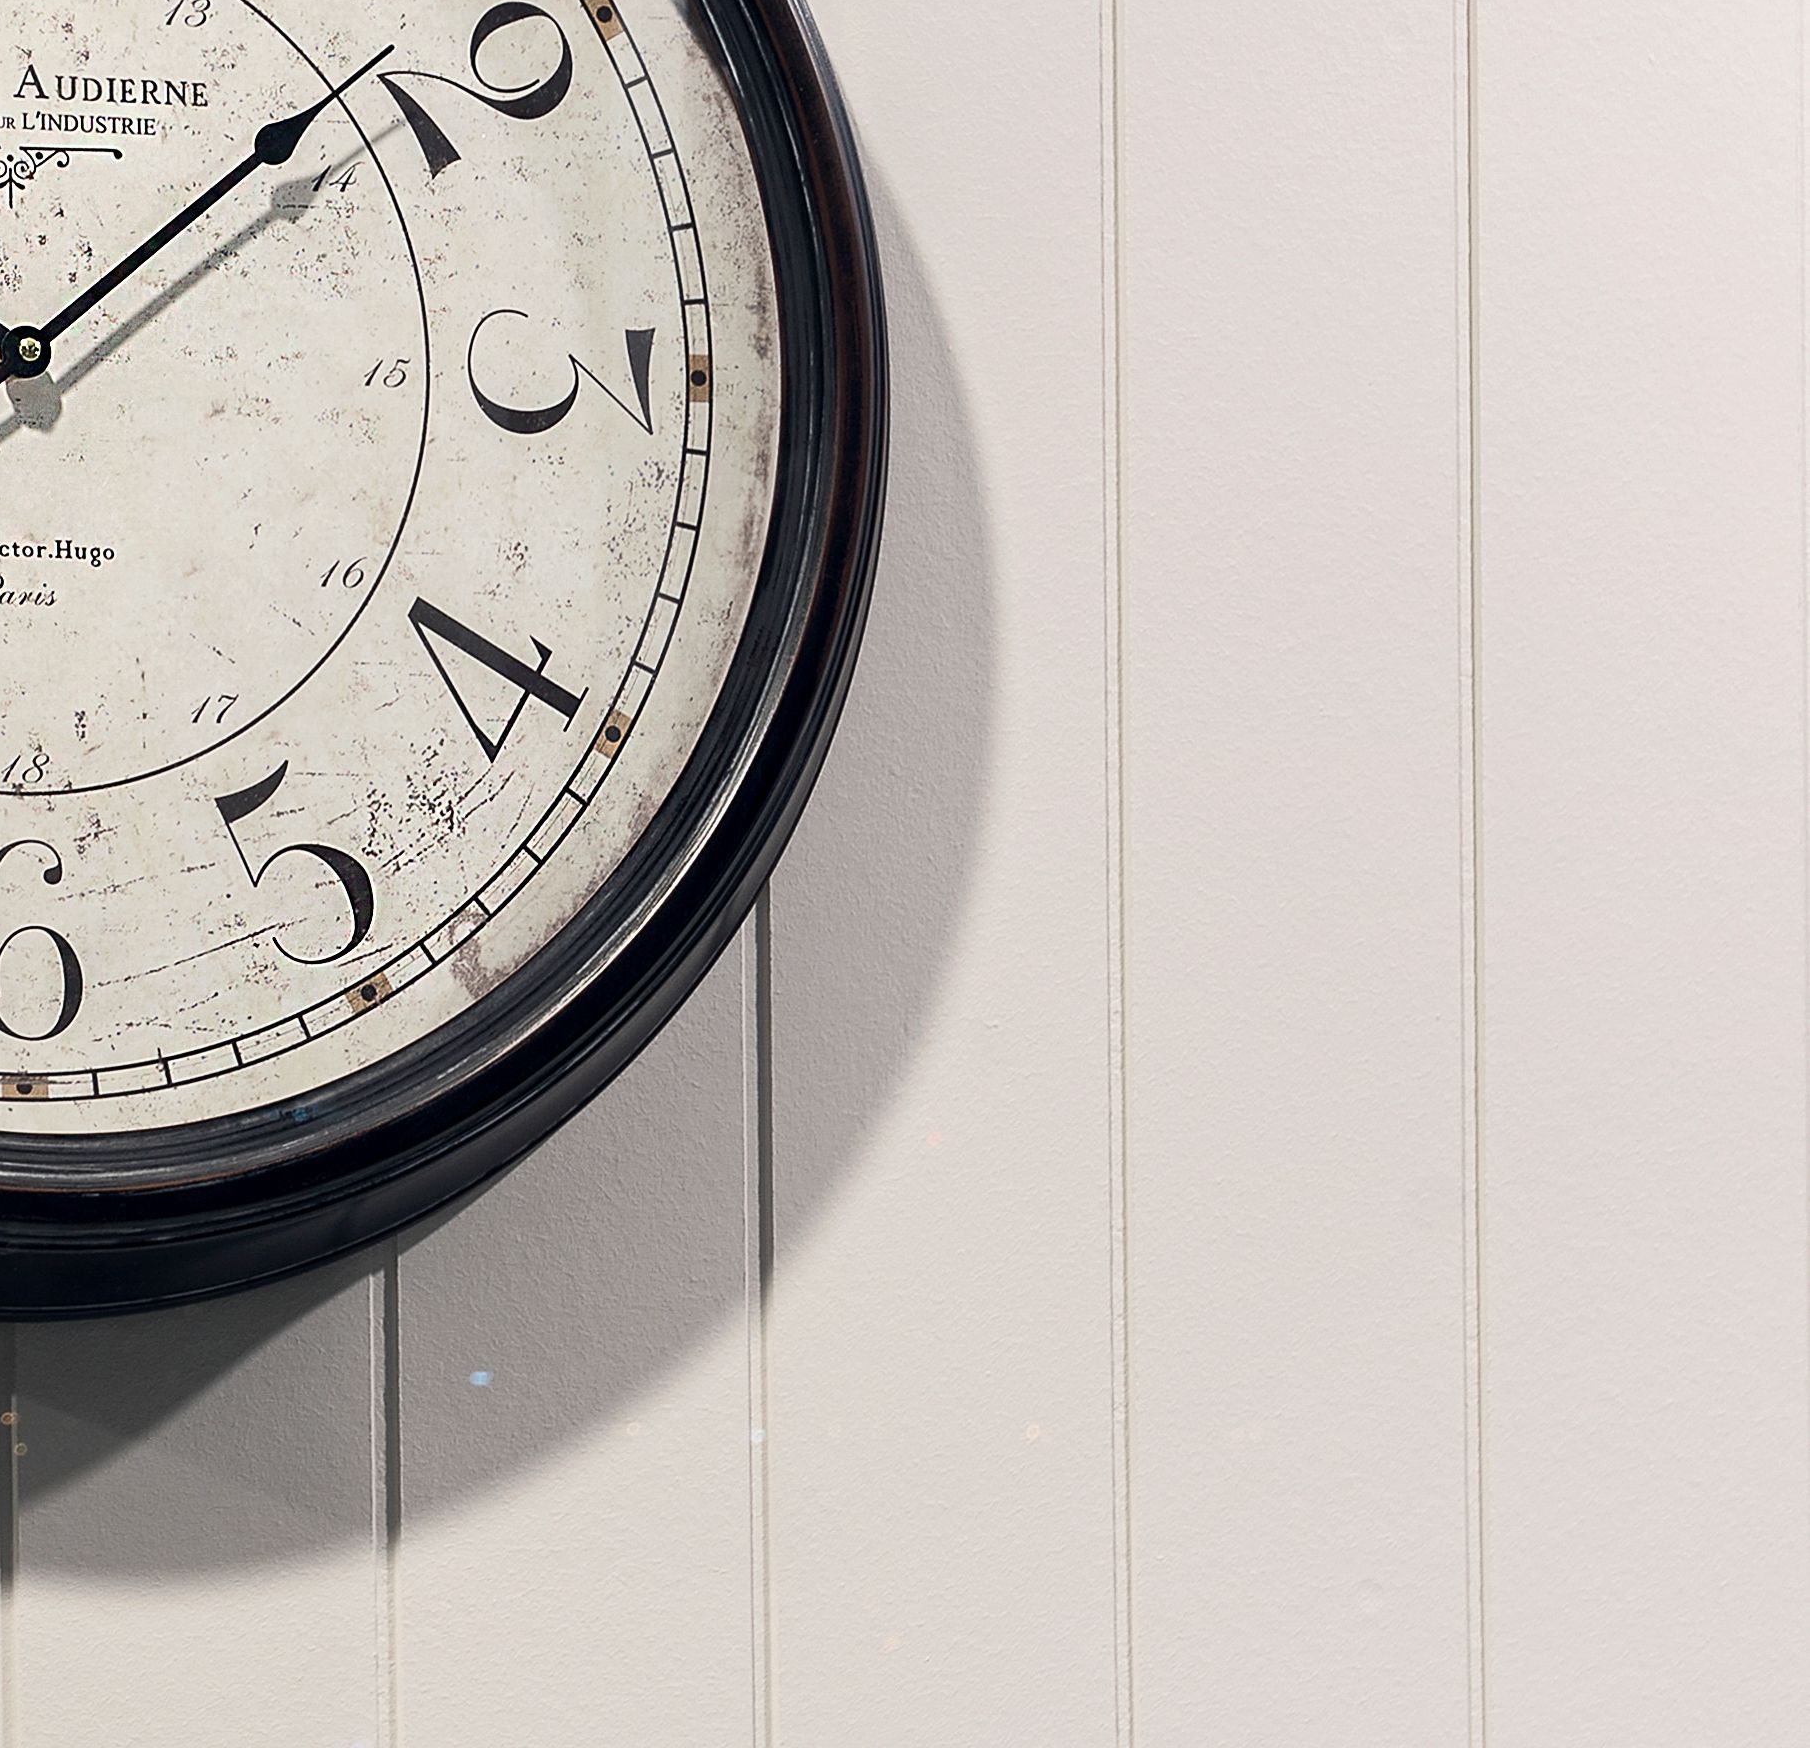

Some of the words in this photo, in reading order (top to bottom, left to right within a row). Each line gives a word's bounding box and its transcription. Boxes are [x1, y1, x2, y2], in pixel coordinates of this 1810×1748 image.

[15, 64, 209, 108] AUDIERNE
[21, 111, 156, 136] L'INDUSTRIE
[310, 162, 357, 193] 14
[363, 358, 409, 390] 15
[467, 307, 657, 435] 3
[320, 558, 366, 590] 16
[408, 596, 590, 763] 4
[191, 693, 238, 725] 17
[0, 753, 50, 784] 18
[215, 759, 374, 966] 5
